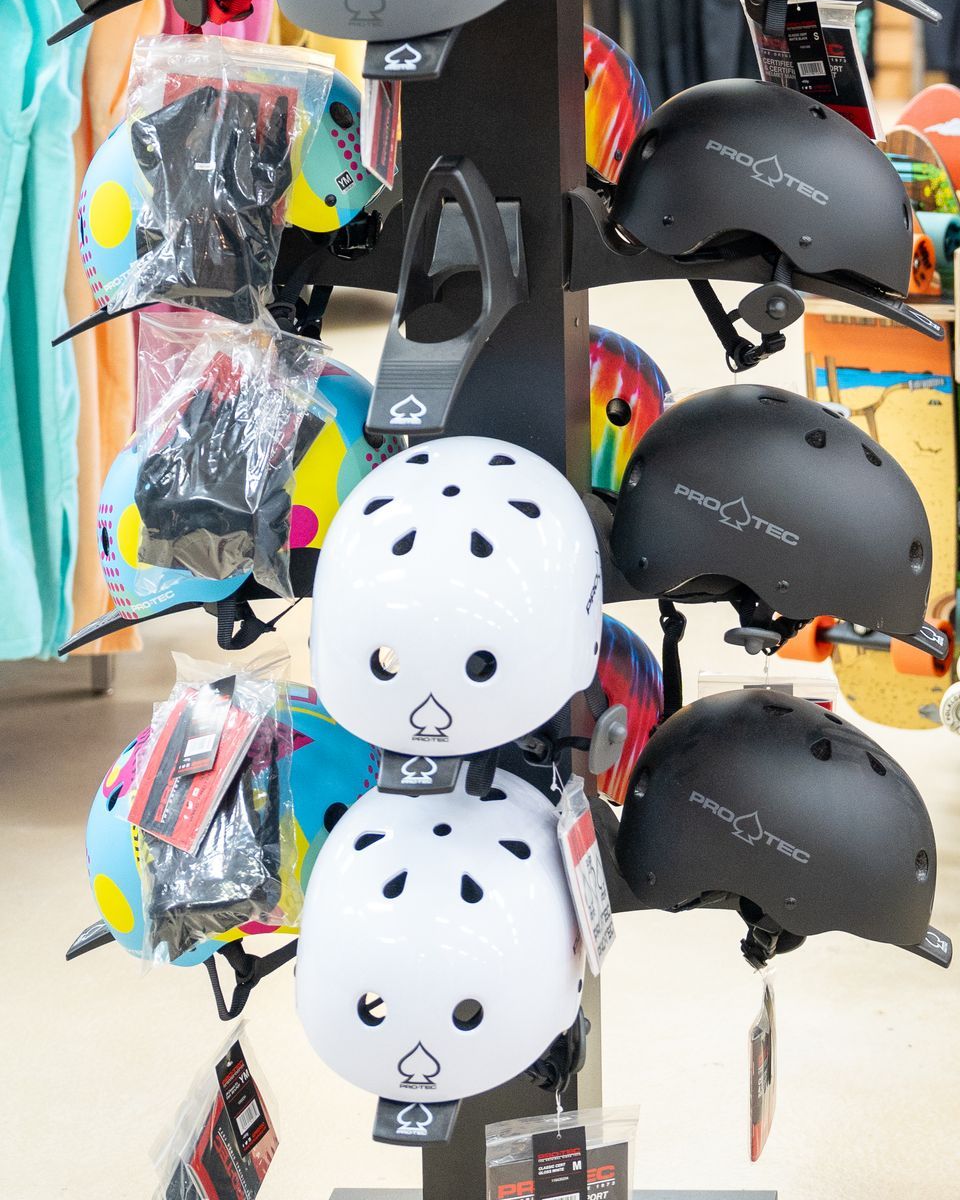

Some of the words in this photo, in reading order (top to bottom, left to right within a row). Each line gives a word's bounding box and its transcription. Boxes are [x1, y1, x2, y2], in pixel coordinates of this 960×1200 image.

[813, 31, 820, 40] S
[337, 173, 352, 188] YM
[238, 1068, 250, 1084] YM
[572, 1160, 582, 1171] M
